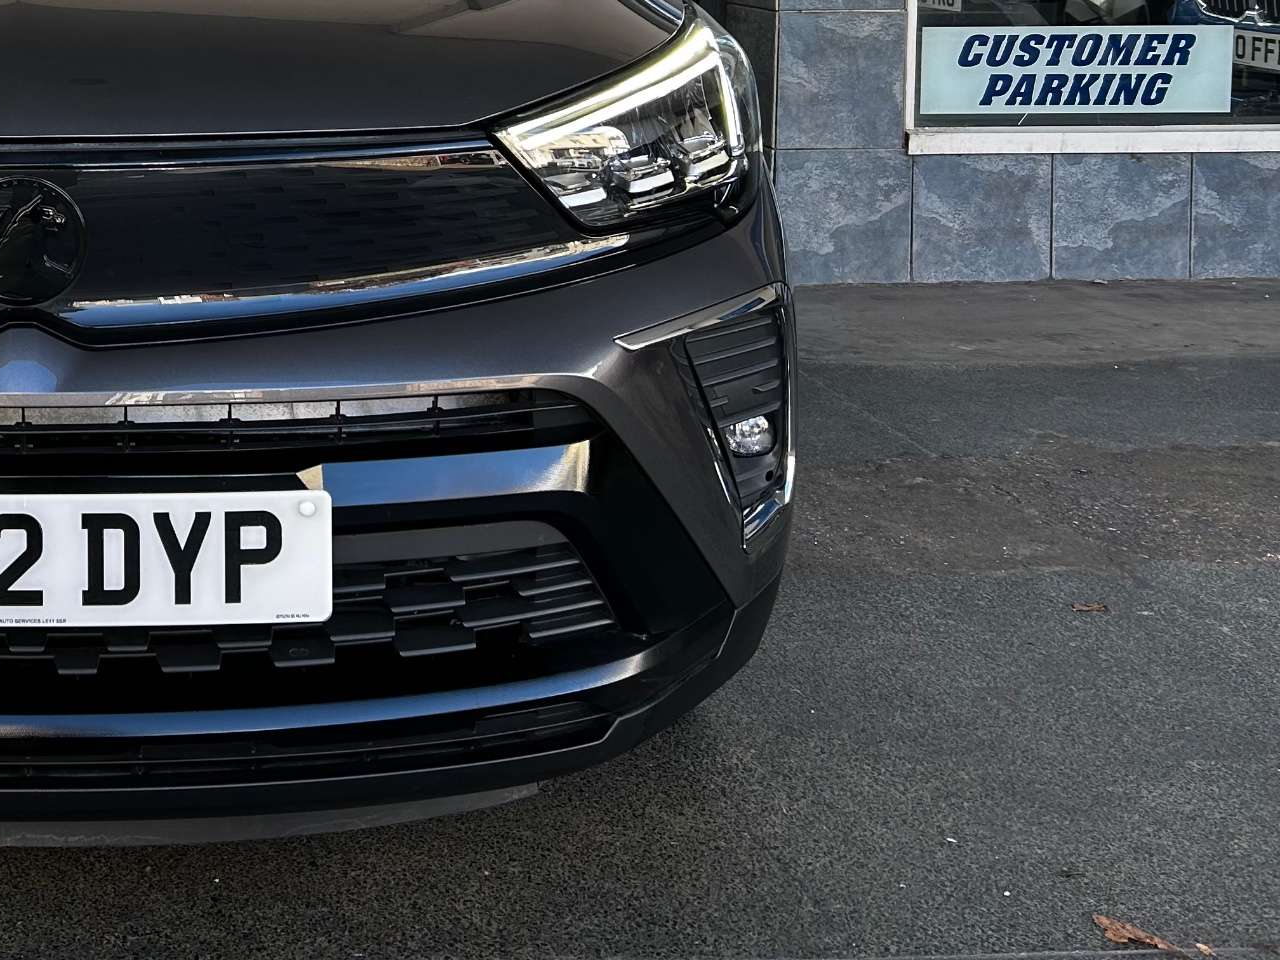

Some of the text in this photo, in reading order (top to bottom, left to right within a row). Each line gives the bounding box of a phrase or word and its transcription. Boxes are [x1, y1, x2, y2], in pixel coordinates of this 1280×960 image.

[957, 33, 1197, 68] CUSTOMER
[1251, 36, 1280, 65] FF
[978, 72, 1173, 107] PARKING
[81, 510, 283, 606] DYP
